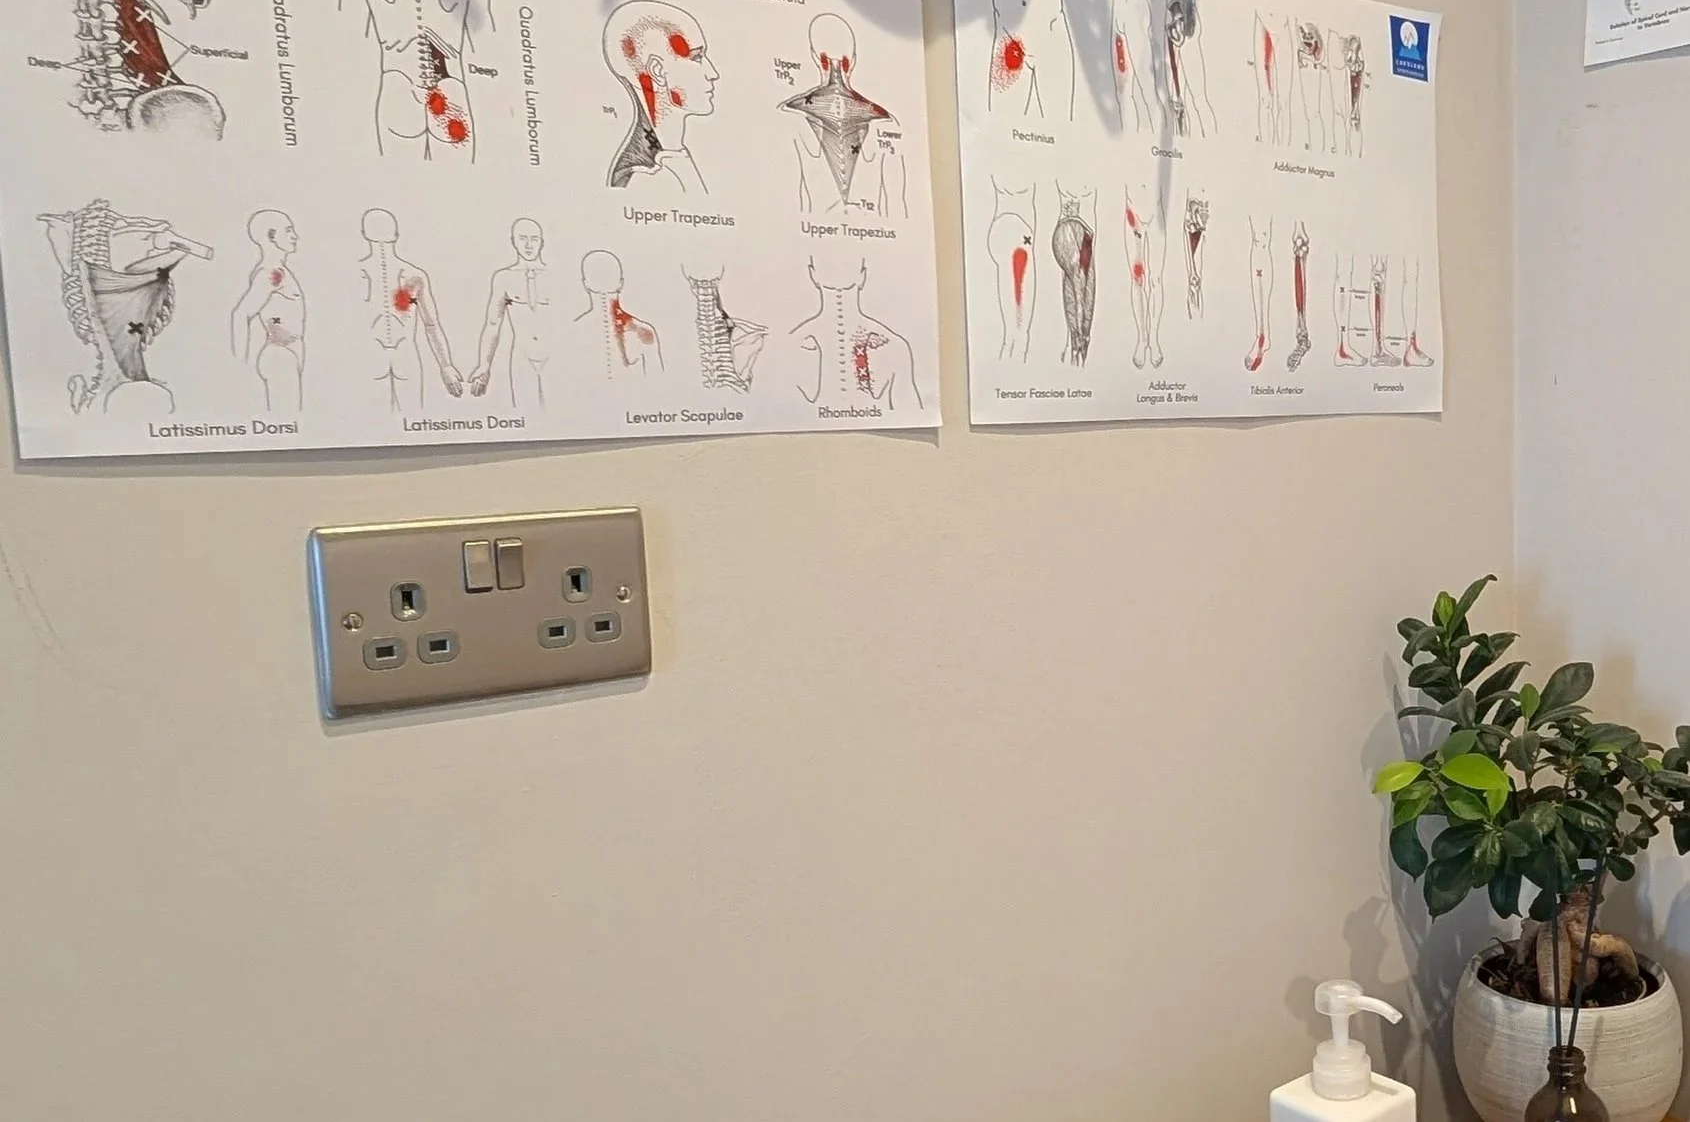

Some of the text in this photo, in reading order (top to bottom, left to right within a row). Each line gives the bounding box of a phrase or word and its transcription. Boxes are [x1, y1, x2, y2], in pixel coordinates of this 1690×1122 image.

[190, 44, 249, 61] Superficial
[27, 57, 62, 71] Deep
[467, 63, 499, 79] Deep
[773, 57, 801, 70] Upper
[519, 5, 540, 167] Quadratus Lumborum
[279, 63, 299, 147] Lumborum
[876, 128, 902, 140] Lower
[1273, 161, 1336, 179] Adductor Magnus
[622, 206, 736, 228] Upper Trapezius
[800, 221, 897, 241] Upper Trapezius
[995, 388, 1093, 399] Tensor Fasciae Latae
[1148, 380, 1187, 392] Adductor
[1250, 385, 1305, 396] Tibialis Anterior
[1136, 392, 1165, 405] Longus
[1175, 392, 1199, 403] Brevis
[625, 408, 744, 425] Levator Scapulae
[817, 405, 883, 420] Rhomboids
[148, 419, 299, 439] Latissimus Dorsi
[402, 415, 526, 433] Latissimus Dorsi
